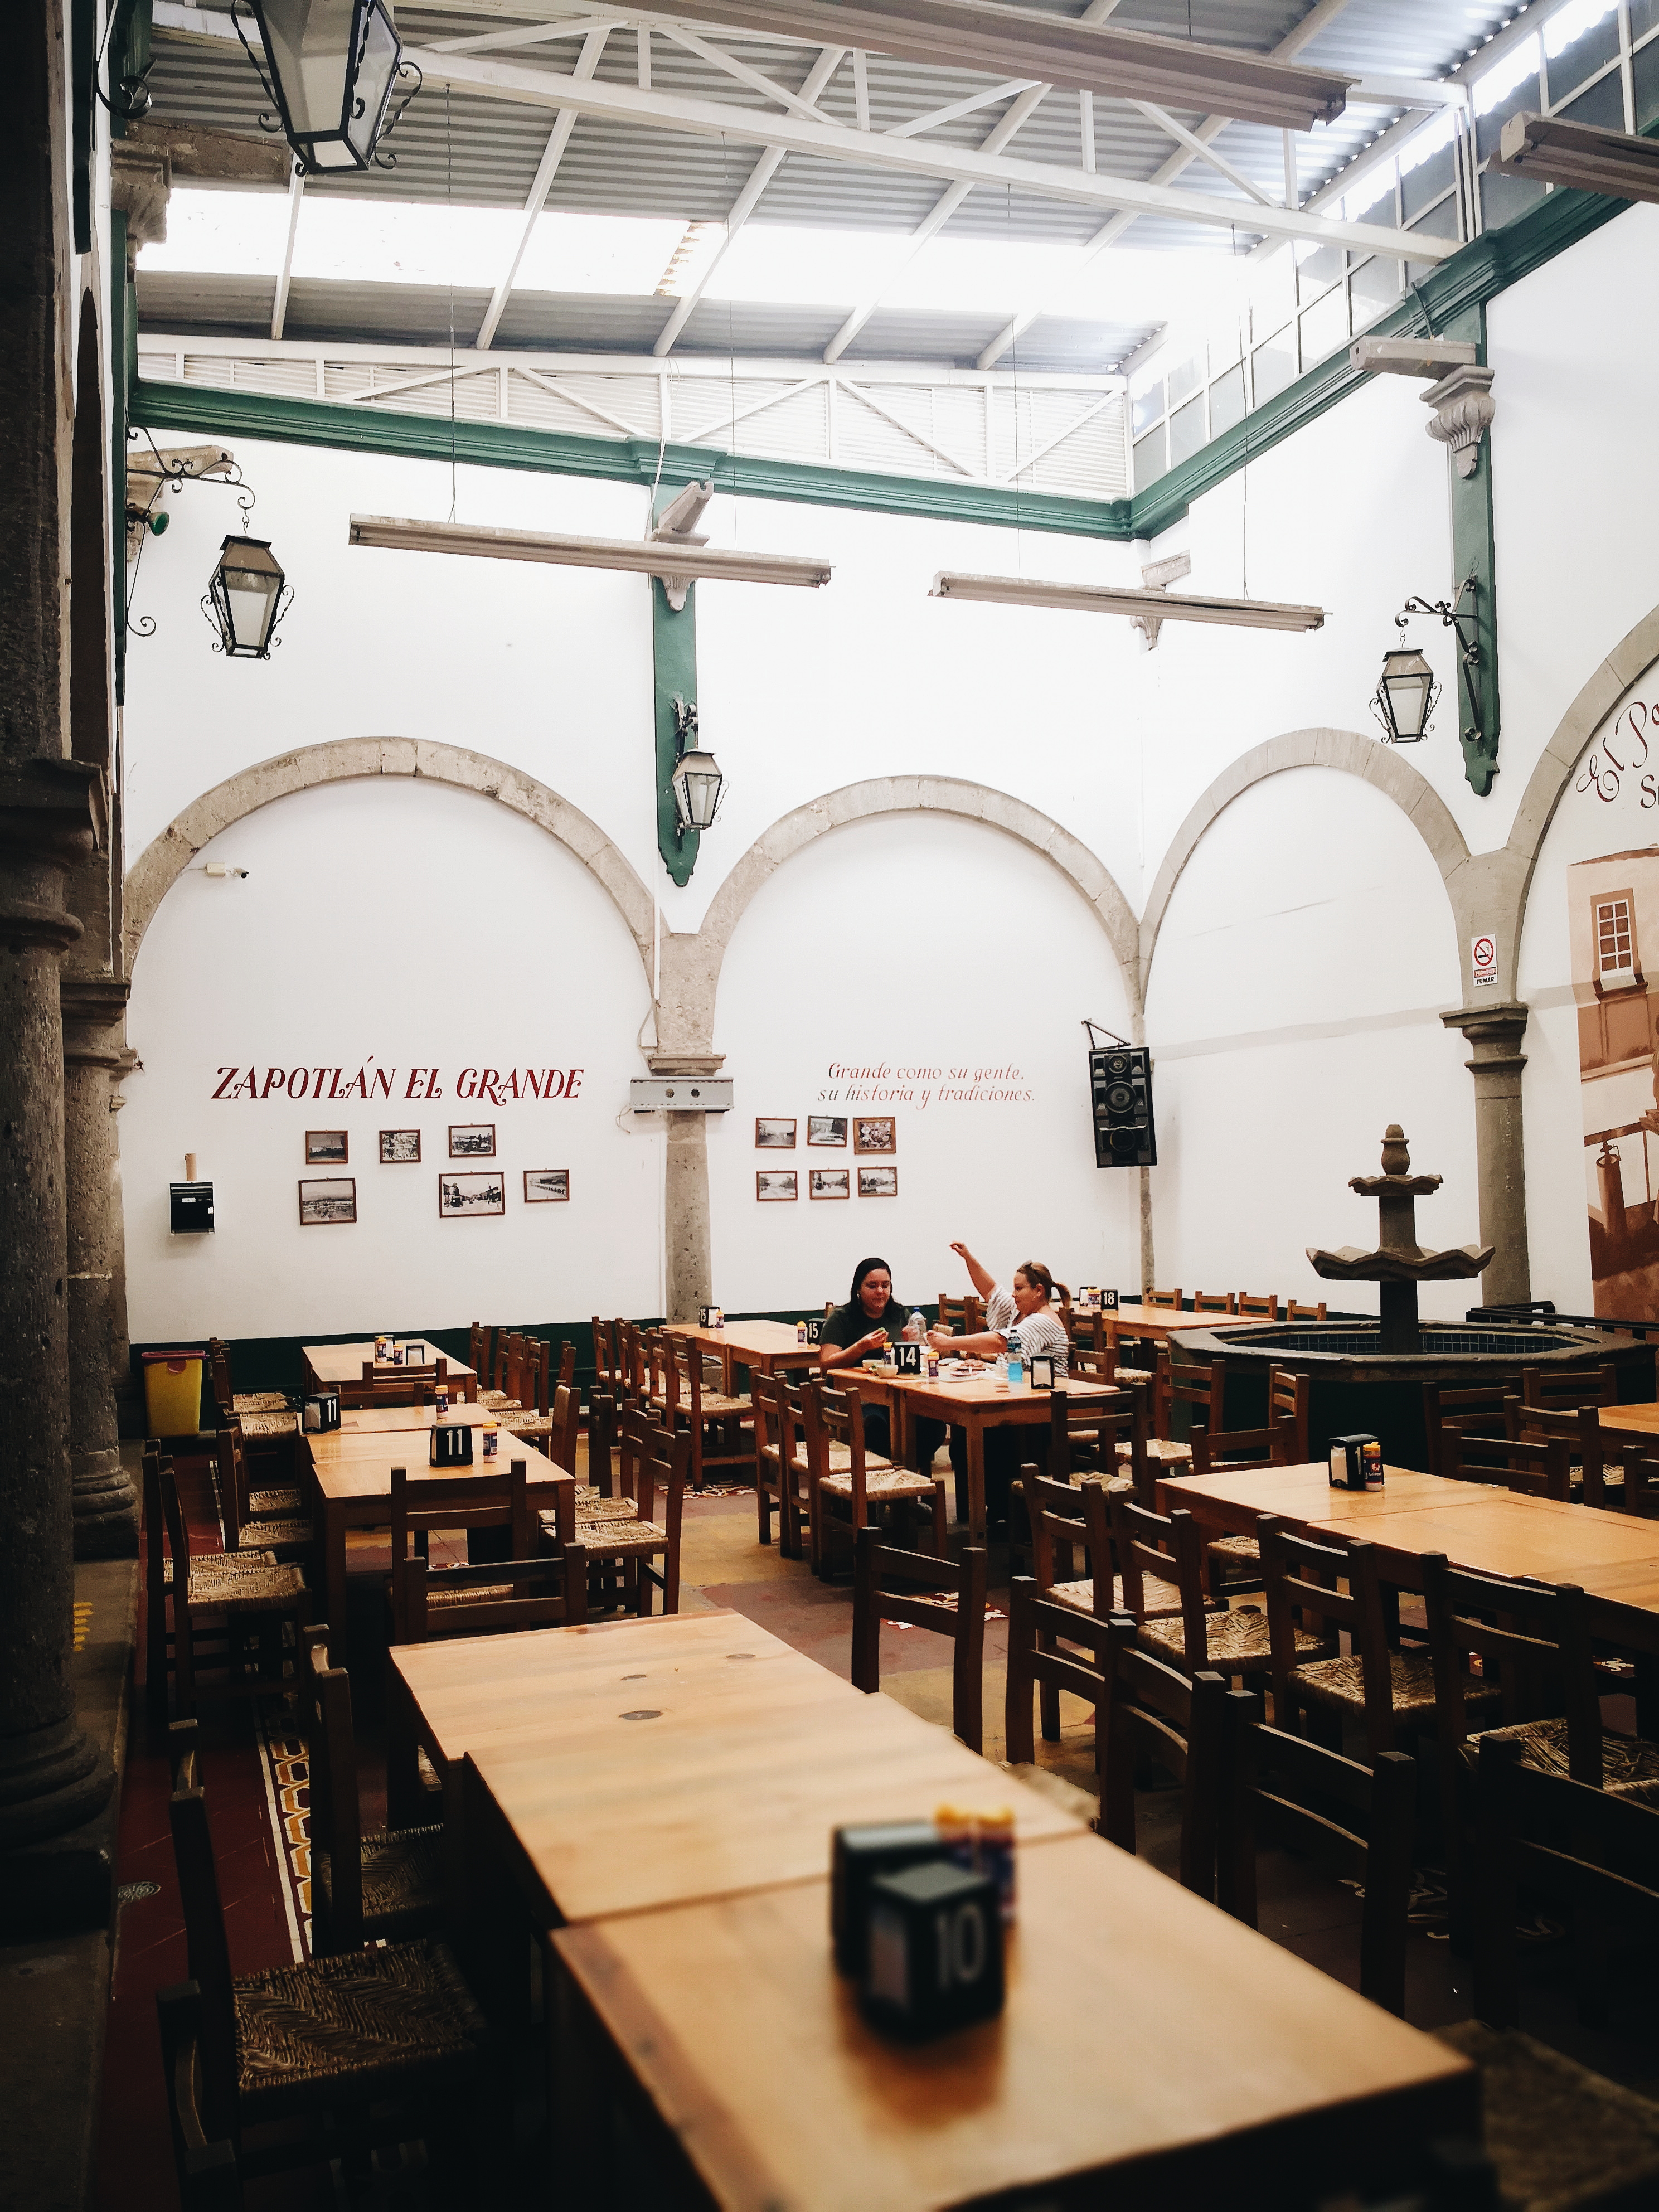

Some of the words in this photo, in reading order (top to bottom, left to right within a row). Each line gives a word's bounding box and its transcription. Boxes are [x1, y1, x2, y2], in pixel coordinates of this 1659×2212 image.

[1576, 736, 1624, 803] El
[1640, 774, 1659, 808] S
[210, 1055, 396, 1099] ZAPOTLÁN
[402, 1068, 443, 1099] EL
[456, 1068, 584, 1107] GRANDE
[828, 1061, 891, 1079] Grande
[896, 1068, 942, 1079] como
[948, 1068, 968, 1080] su
[817, 1089, 839, 1102] su
[845, 1084, 914, 1101] historia
[916, 1089, 931, 1110] y
[938, 1084, 1035, 1102] tradiciones.
[1103, 1292, 1115, 1306] 18
[808, 1322, 818, 1339] 15
[899, 1346, 916, 1366] 14
[327, 1398, 337, 1422] 11
[447, 1429, 463, 1456] 11
[937, 1903, 985, 1993] 10
